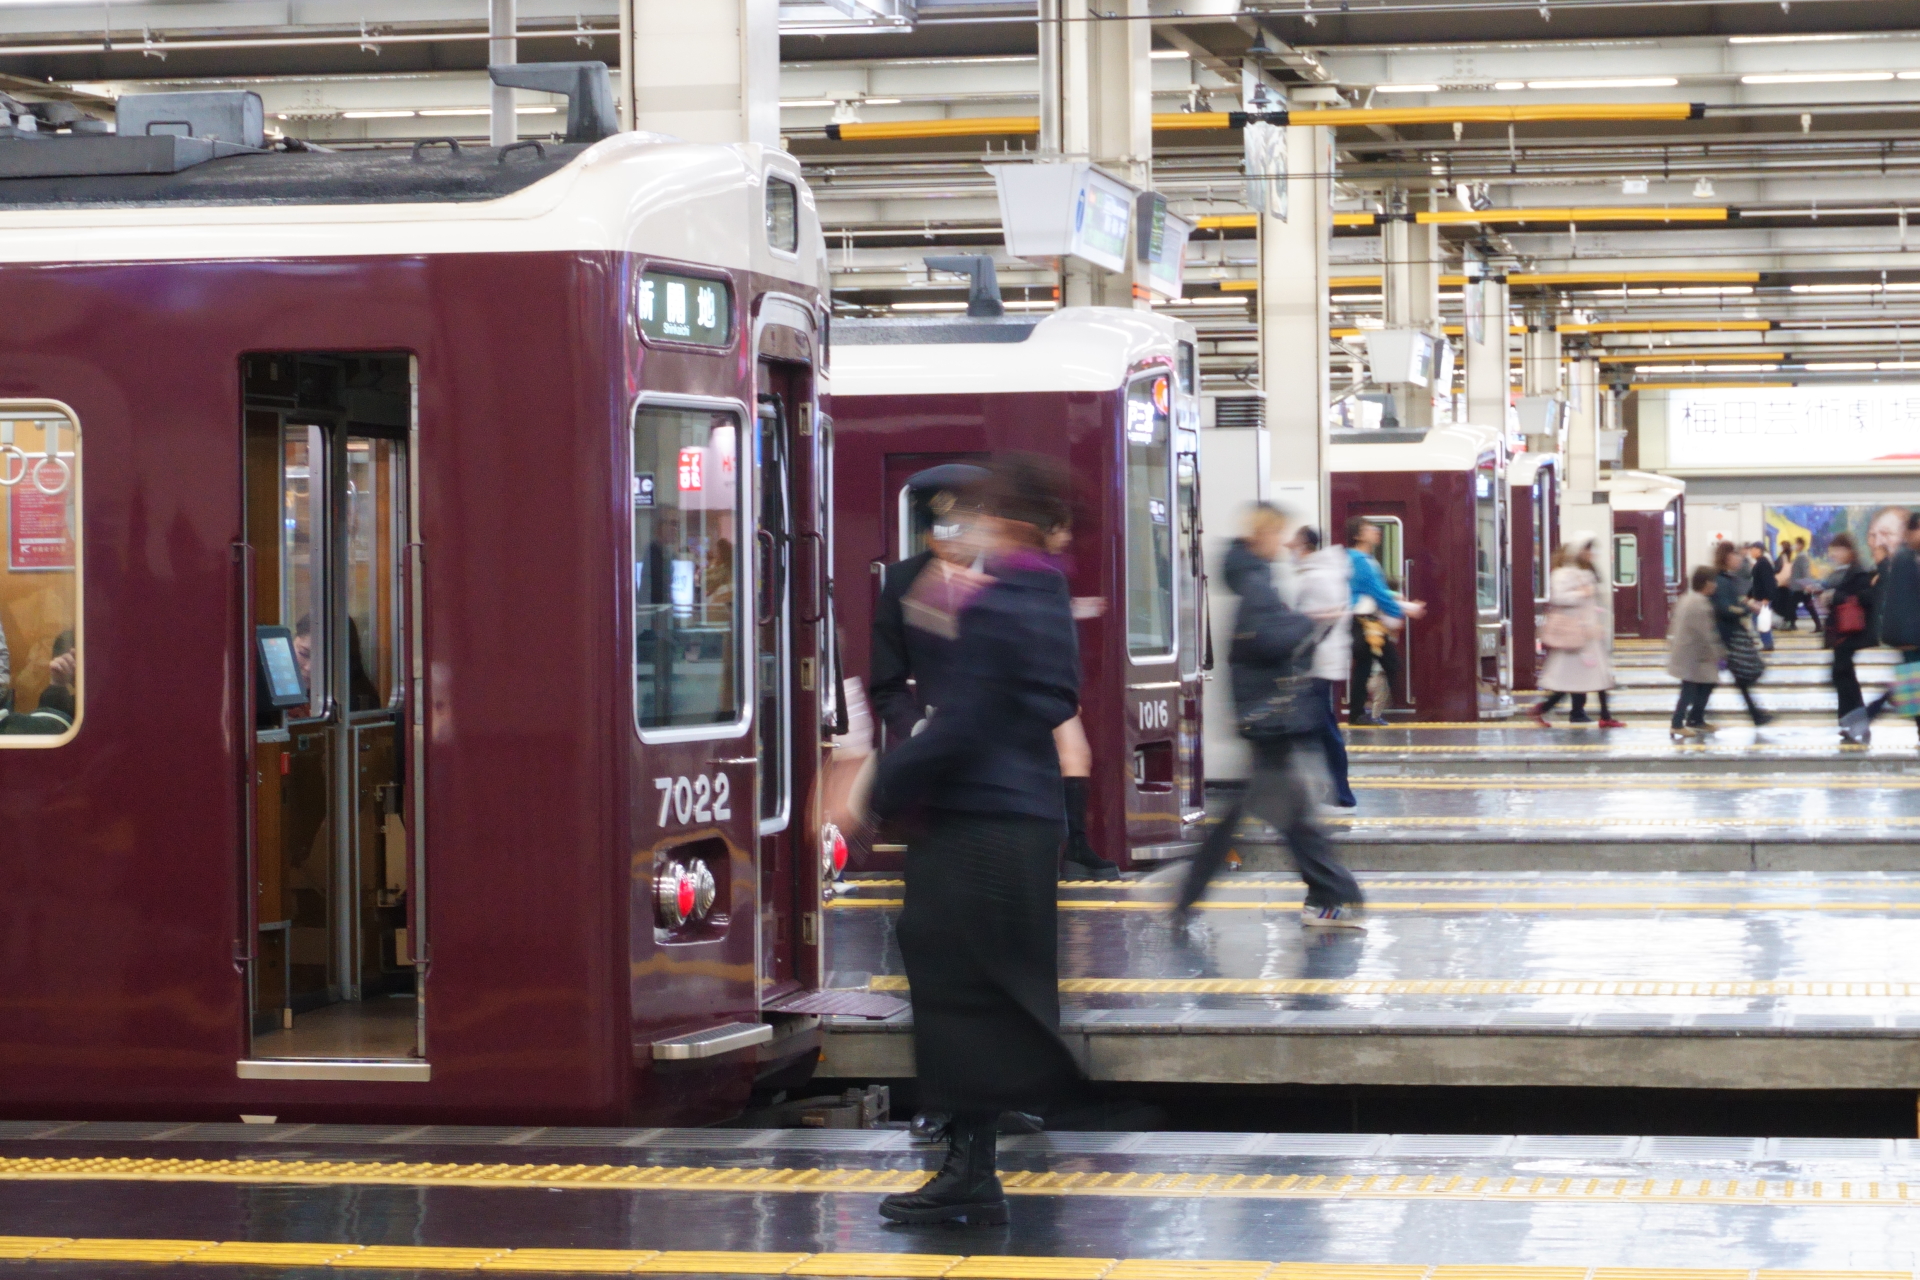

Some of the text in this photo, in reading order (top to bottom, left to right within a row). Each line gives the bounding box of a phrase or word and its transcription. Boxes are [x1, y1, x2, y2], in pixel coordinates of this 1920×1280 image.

[1682, 397, 1920, 435] 梅田芸術劇場
[1139, 700, 1168, 730] 1016
[654, 772, 732, 828] 7022
